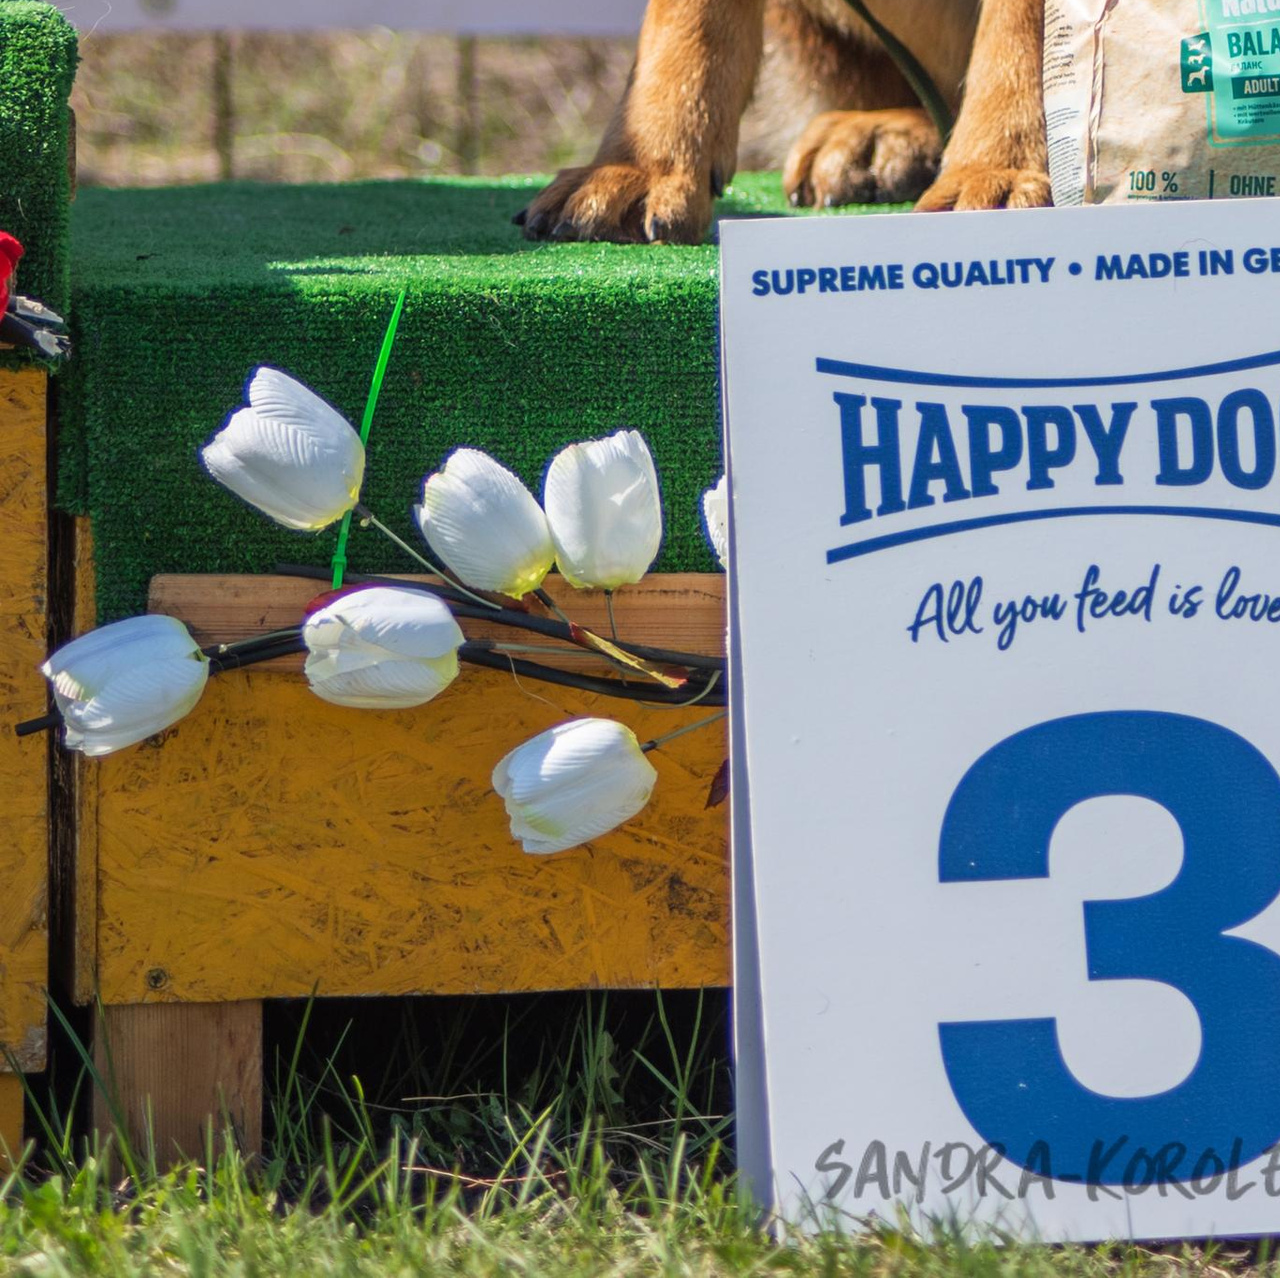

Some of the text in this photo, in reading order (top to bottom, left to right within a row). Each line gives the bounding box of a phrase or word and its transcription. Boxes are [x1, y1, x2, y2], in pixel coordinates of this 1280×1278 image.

[1243, 77, 1280, 95] ADULT
[1129, 169, 1178, 193] 100 %
[1230, 175, 1276, 197] OHNE
[751, 264, 904, 296] SUPREME
[912, 257, 1056, 289] QUALITY
[1095, 252, 1190, 281] MADE
[1199, 249, 1234, 276] IN
[832, 391, 1138, 527] HAPPY
[907, 575, 983, 644] All
[993, 593, 1067, 651] you
[1073, 563, 1161, 633] feed
[1168, 584, 1203, 615] is
